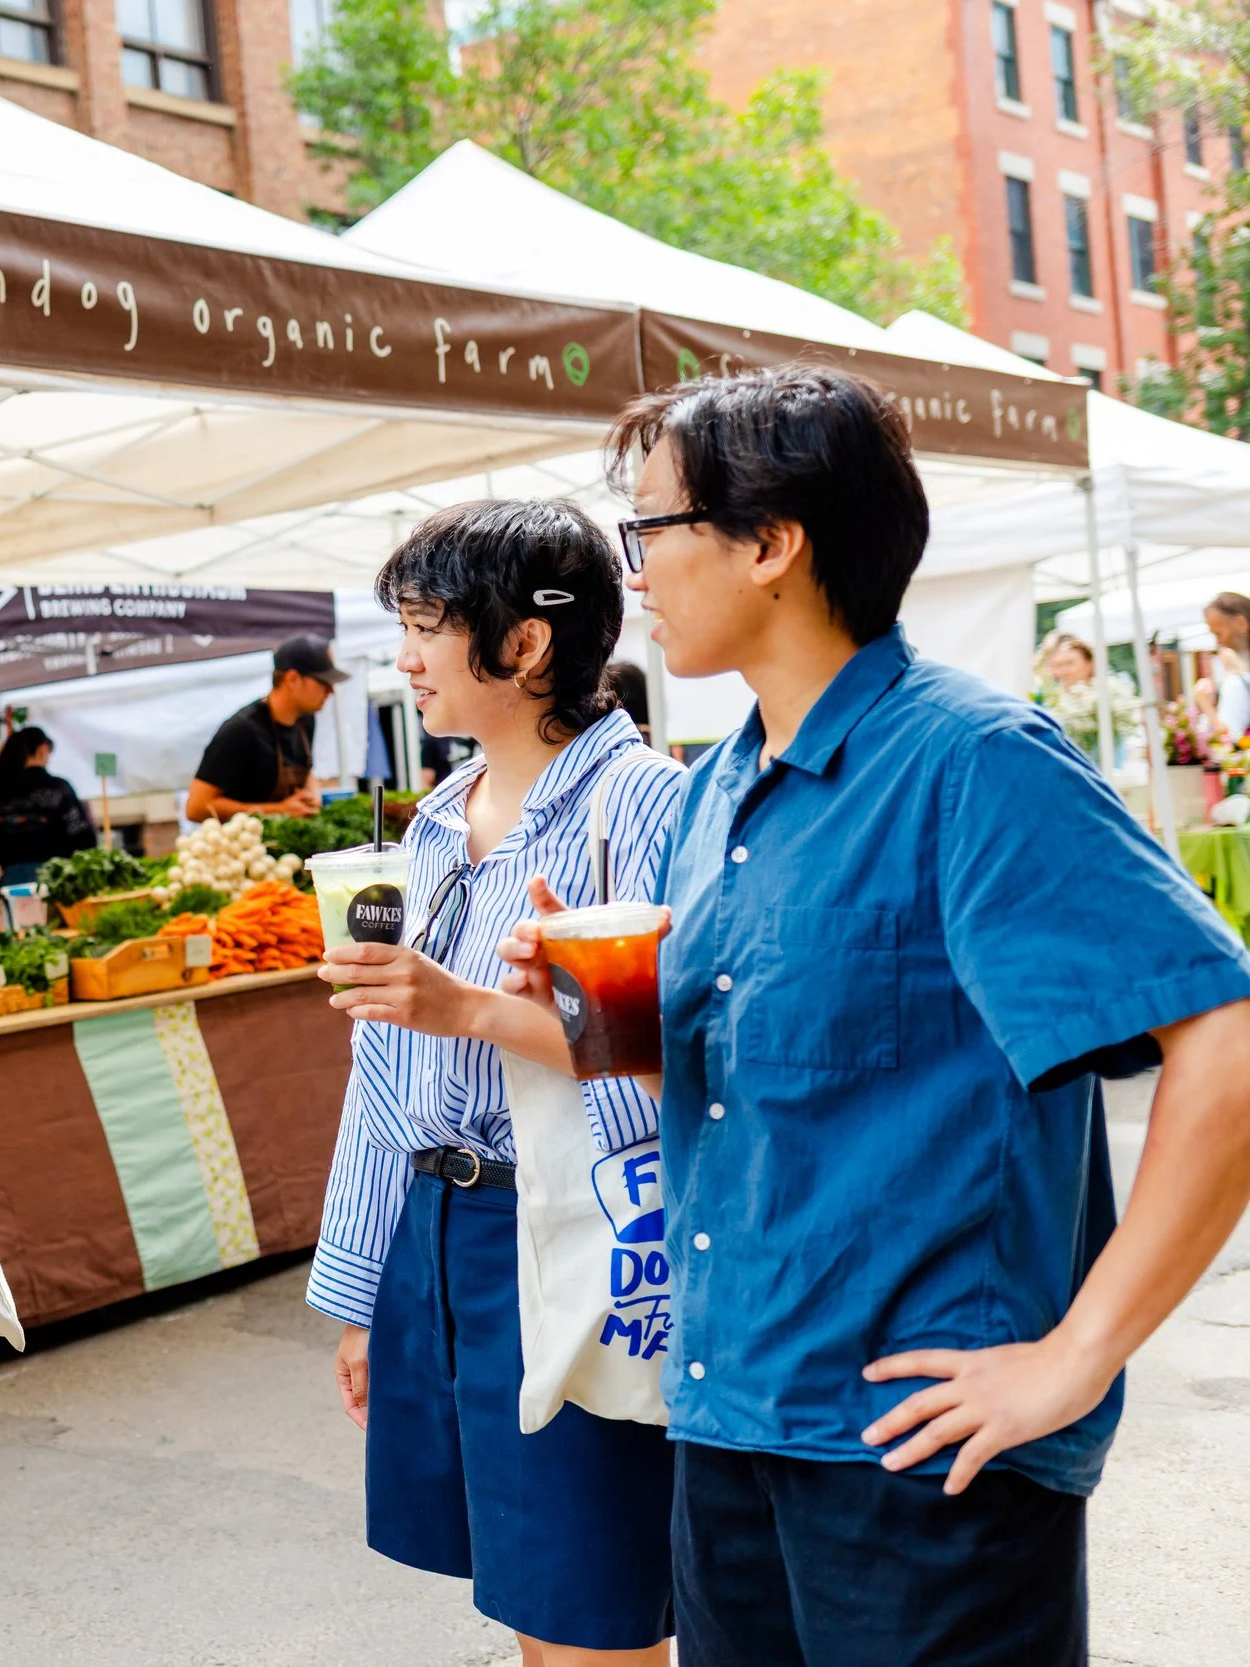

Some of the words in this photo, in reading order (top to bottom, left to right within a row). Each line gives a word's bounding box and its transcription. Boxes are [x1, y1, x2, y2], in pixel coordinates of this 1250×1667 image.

[193, 298, 393, 367] organic
[434, 317, 554, 391] farm
[989, 388, 1059, 442] farm
[39, 598, 113, 619] BREWING
[112, 598, 186, 619] COMPANY
[355, 903, 402, 923] FAWKES
[361, 920, 395, 930] COFFEE
